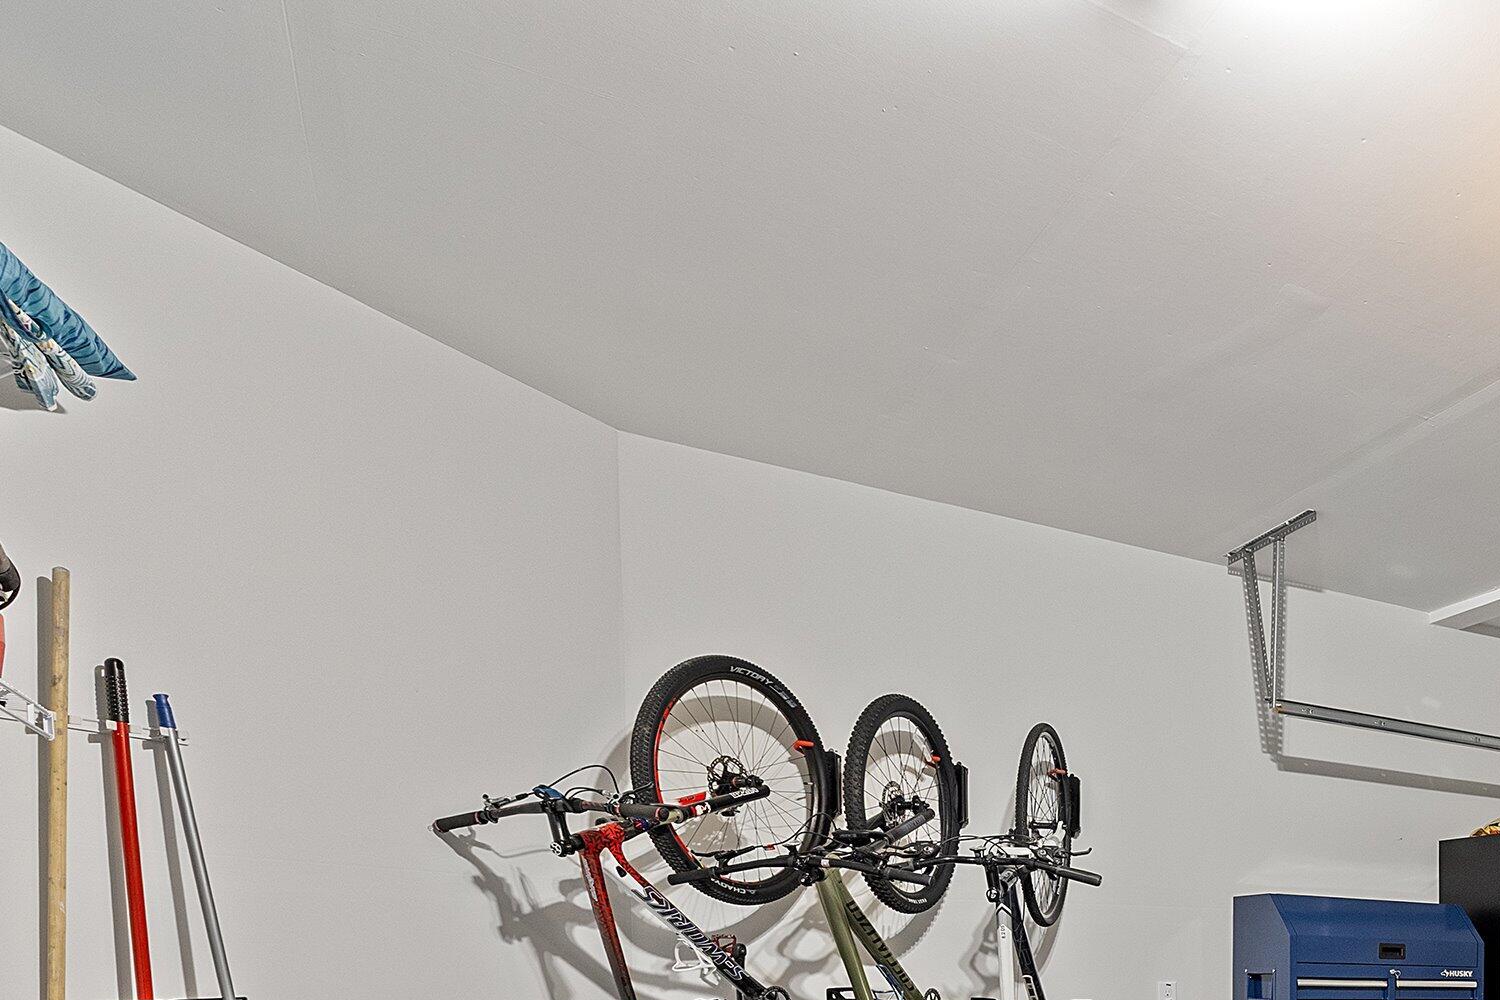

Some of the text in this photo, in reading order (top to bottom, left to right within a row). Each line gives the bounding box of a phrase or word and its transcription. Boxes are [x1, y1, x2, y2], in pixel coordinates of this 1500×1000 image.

[730, 665, 774, 685] VICTORY
[631, 885, 751, 981] S-WORKS
[1449, 970, 1473, 978] HUSKY
